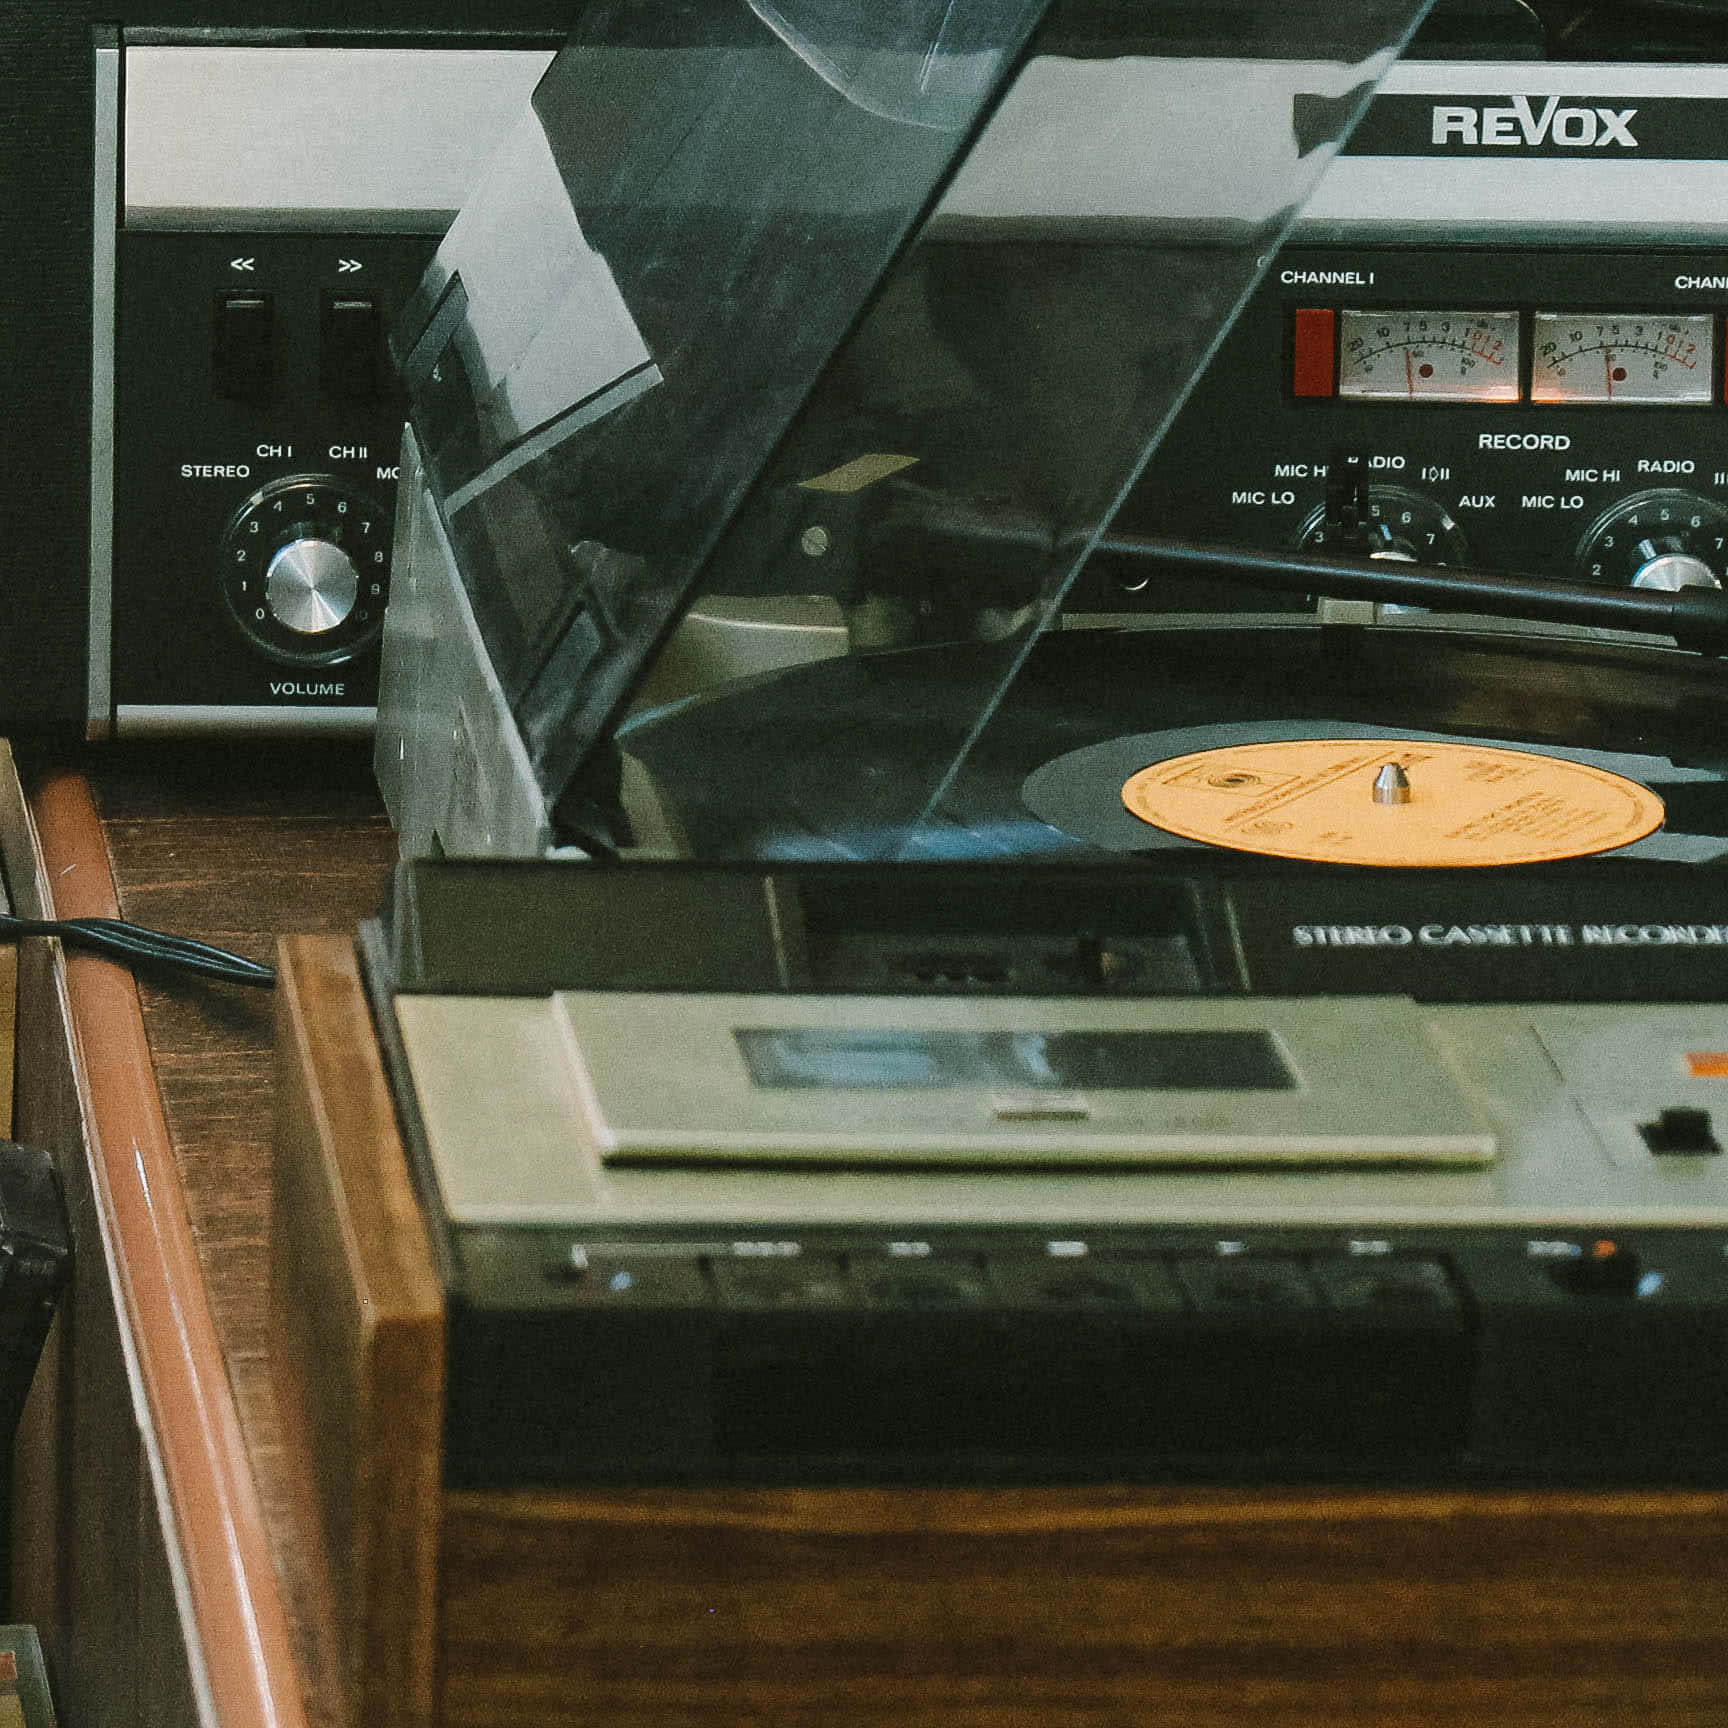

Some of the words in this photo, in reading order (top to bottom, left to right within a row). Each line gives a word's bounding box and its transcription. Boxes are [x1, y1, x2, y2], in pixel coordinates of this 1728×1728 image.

[1280, 270, 1366, 285] CHANNEL
[1478, 433, 1571, 451] RECORD
[256, 444, 285, 458] CH
[328, 445, 357, 459] CH
[180, 464, 251, 478] STEREO
[376, 466, 400, 480] MO
[1274, 463, 1309, 478] MIC
[1313, 464, 1330, 478] H
[1637, 459, 1695, 473] RADIO
[1564, 468, 1599, 483] MIC
[1602, 469, 1621, 483] HI
[305, 493, 315, 505] 5
[1231, 490, 1265, 505] MIC
[1270, 490, 1296, 505] LO
[1458, 494, 1497, 509] AUX
[1521, 494, 1555, 509] MIC
[1560, 494, 1585, 510] LO
[273, 500, 283, 512] 4
[337, 501, 348, 514] 6
[249, 521, 260, 534] 3
[361, 522, 371, 534] 7
[1314, 531, 1324, 544] 3
[1371, 504, 1380, 518] 5
[1401, 511, 1413, 524] 6
[1426, 532, 1436, 545] 7
[1592, 564, 1602, 577] 2
[1604, 536, 1615, 549] 3
[1628, 514, 1639, 527] 4
[1660, 508, 1670, 521] 5
[1690, 515, 1702, 528] 6
[1714, 537, 1724, 550] 7
[236, 549, 247, 562] 2
[374, 550, 384, 563] 8
[371, 583, 381, 595] 9
[269, 682, 346, 696] VOLUME
[1291, 923, 1414, 946] STEREO
[1418, 924, 1573, 946] CASSETTE
